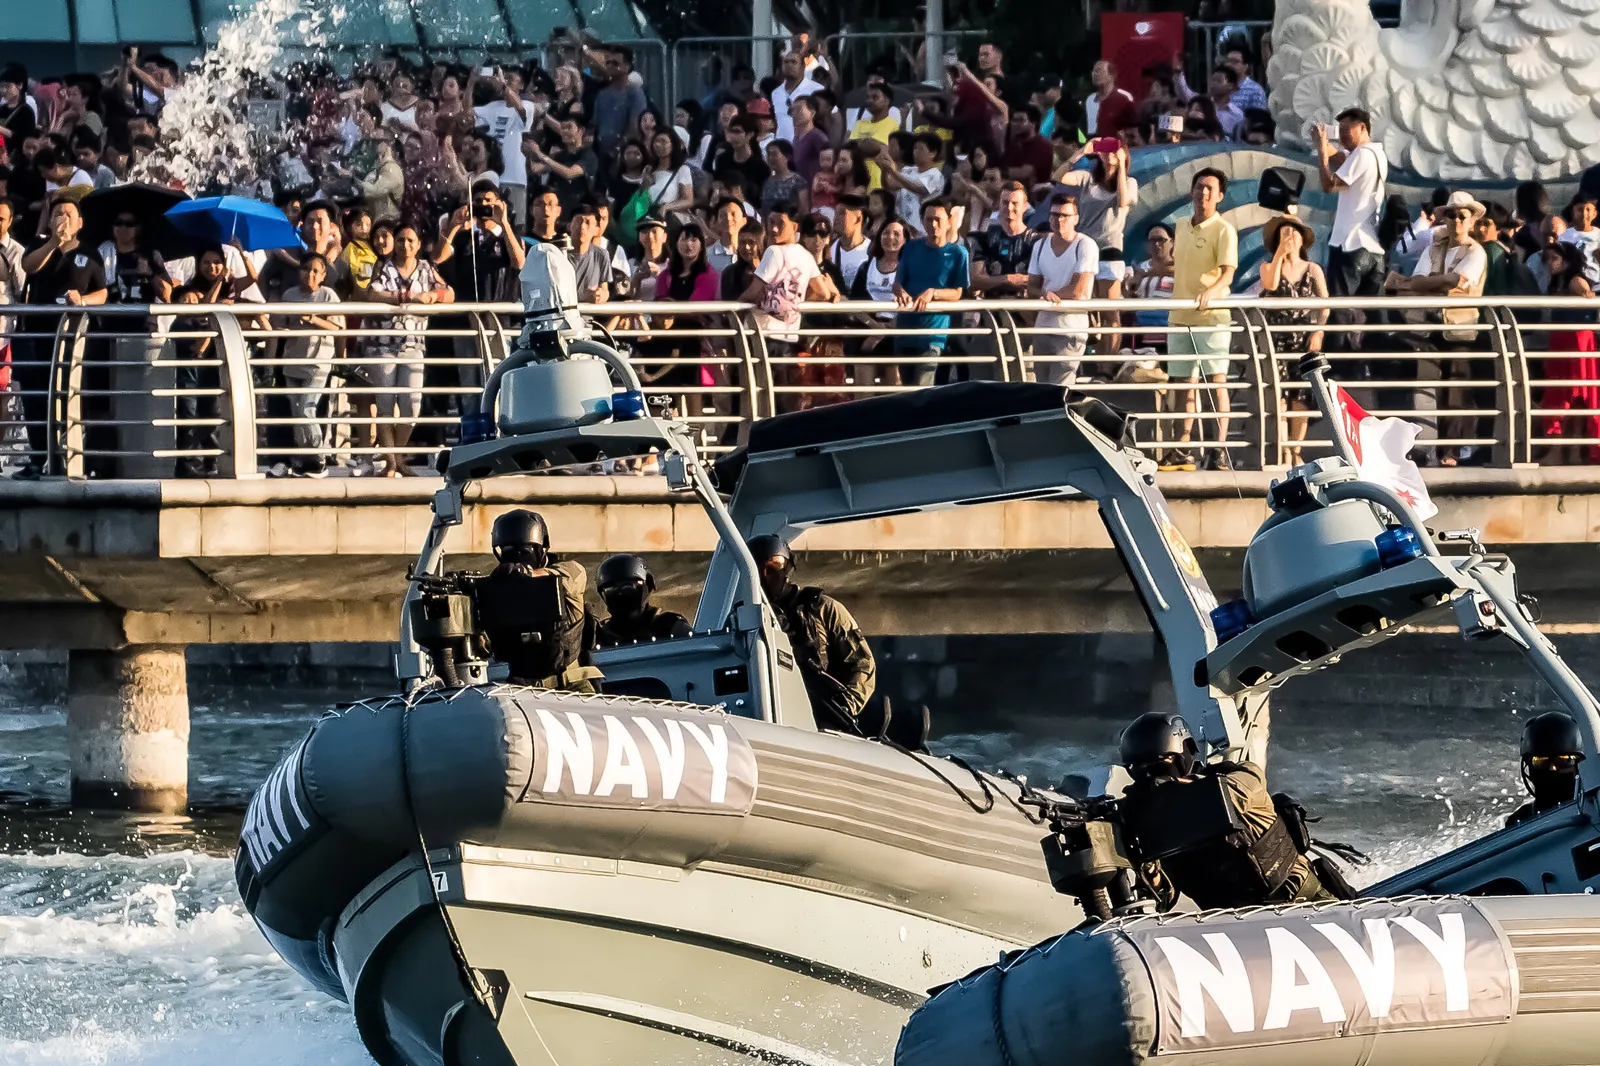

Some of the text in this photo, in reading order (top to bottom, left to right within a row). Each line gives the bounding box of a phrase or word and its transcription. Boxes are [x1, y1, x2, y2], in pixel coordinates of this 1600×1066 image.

[242, 740, 310, 872] NAVY
[535, 709, 730, 803] NAVY
[434, 873, 444, 890] 7
[1154, 912, 1470, 1038] NAVY
